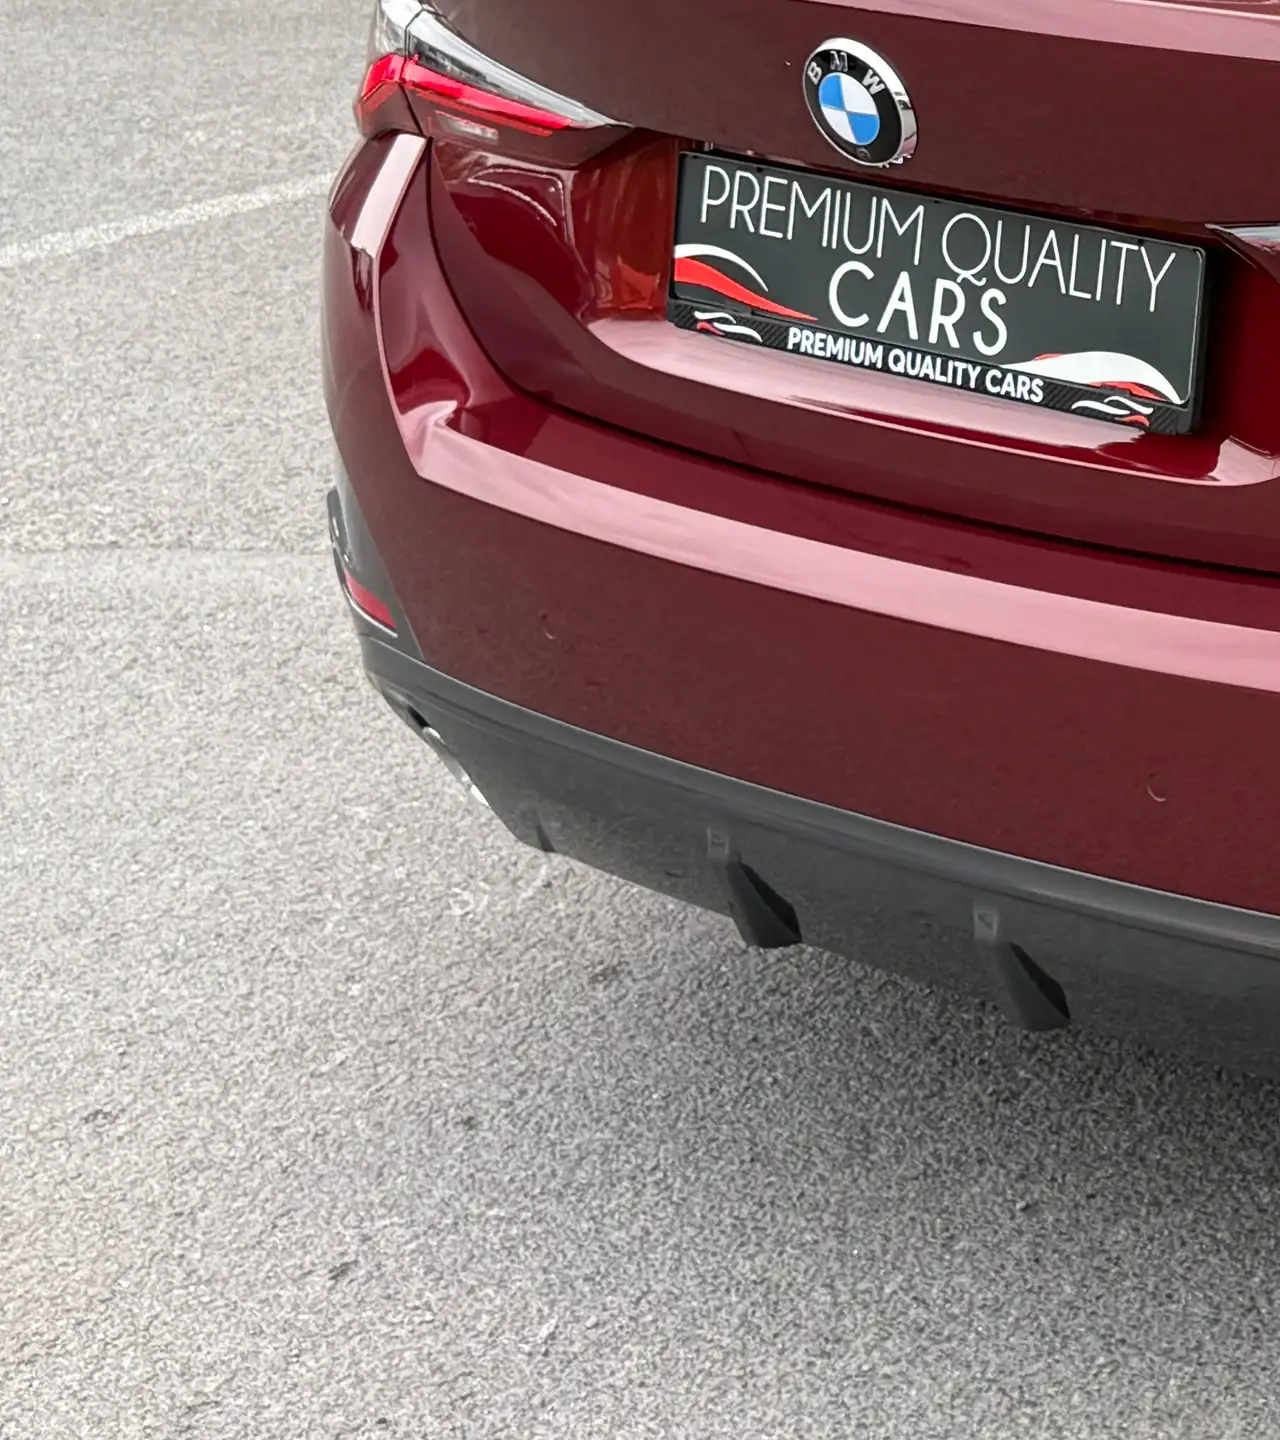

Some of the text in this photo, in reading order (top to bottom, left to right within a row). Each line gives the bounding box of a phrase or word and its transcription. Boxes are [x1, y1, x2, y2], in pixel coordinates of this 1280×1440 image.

[806, 50, 886, 96] BMW
[700, 164, 1177, 313] PREMIUM QUALITY
[828, 260, 1008, 356] CARS
[786, 326, 1045, 404] PREMIUM QUALITY CARS
